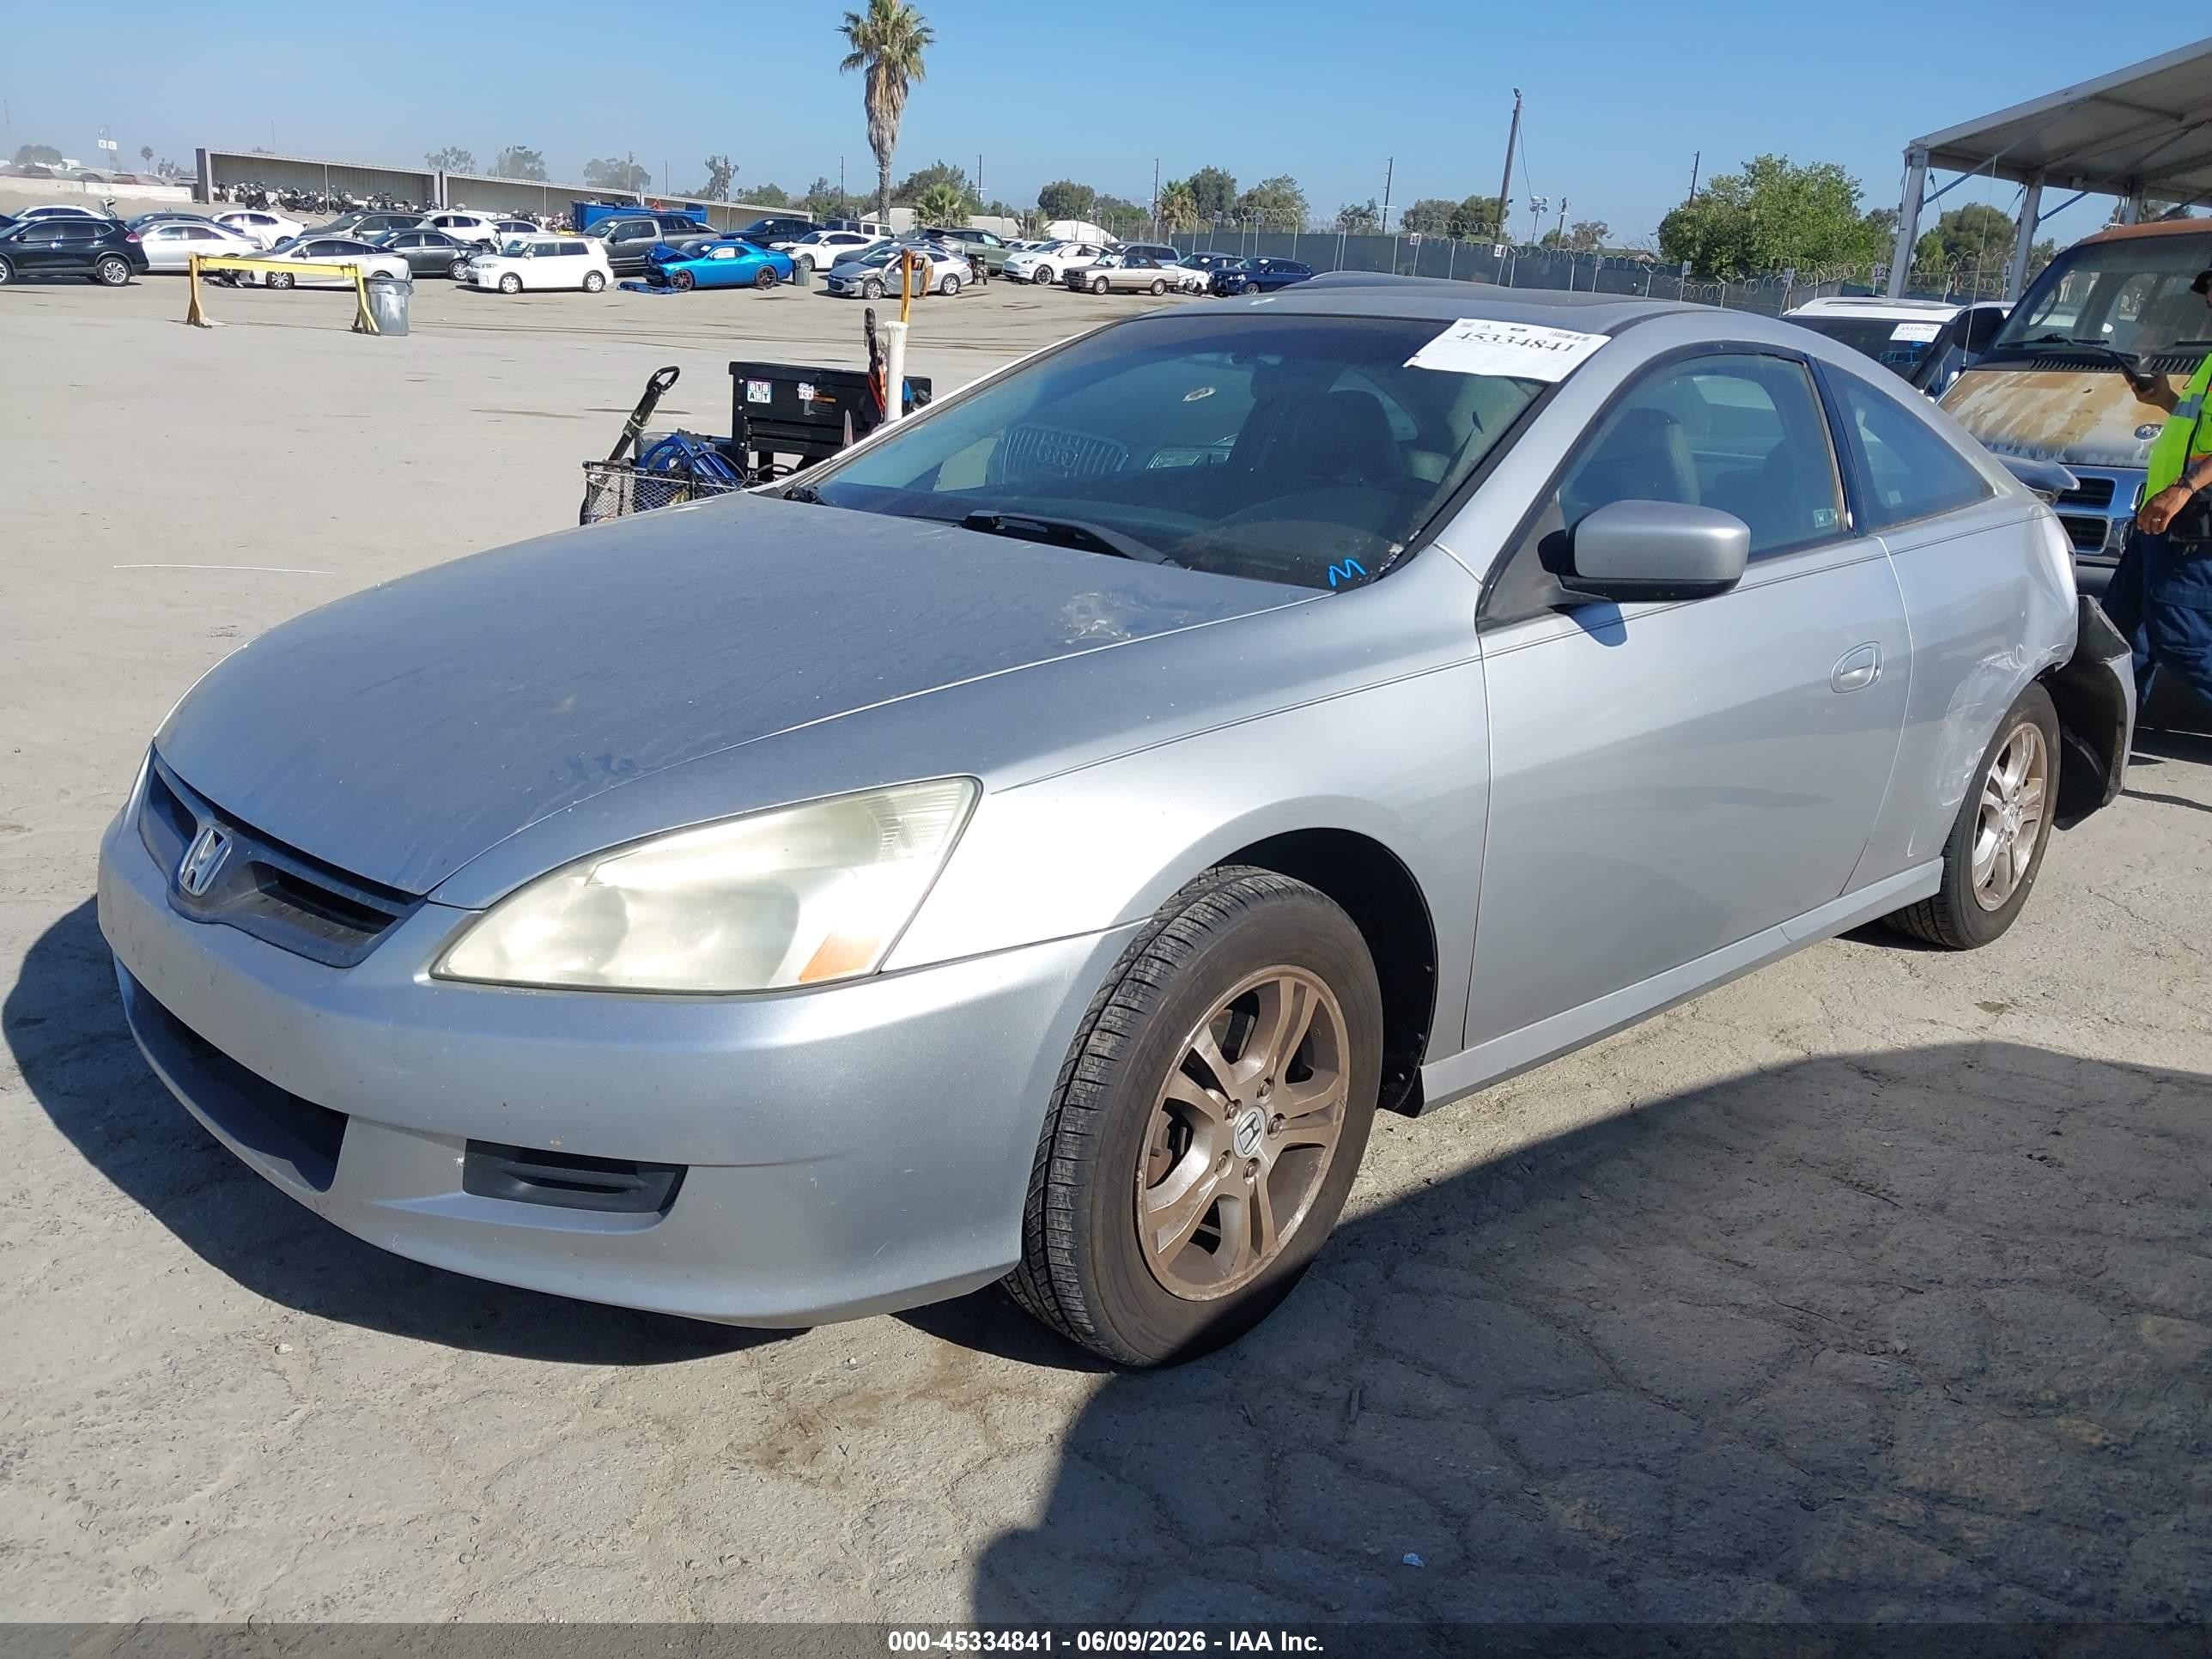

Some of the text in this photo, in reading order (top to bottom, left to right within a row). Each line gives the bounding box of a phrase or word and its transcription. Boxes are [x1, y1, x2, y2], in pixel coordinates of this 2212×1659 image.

[1873, 266, 1886, 276] 12
[1456, 331, 1576, 352] 45334841
[749, 382, 769, 392] 818
[749, 393, 769, 402] ART
